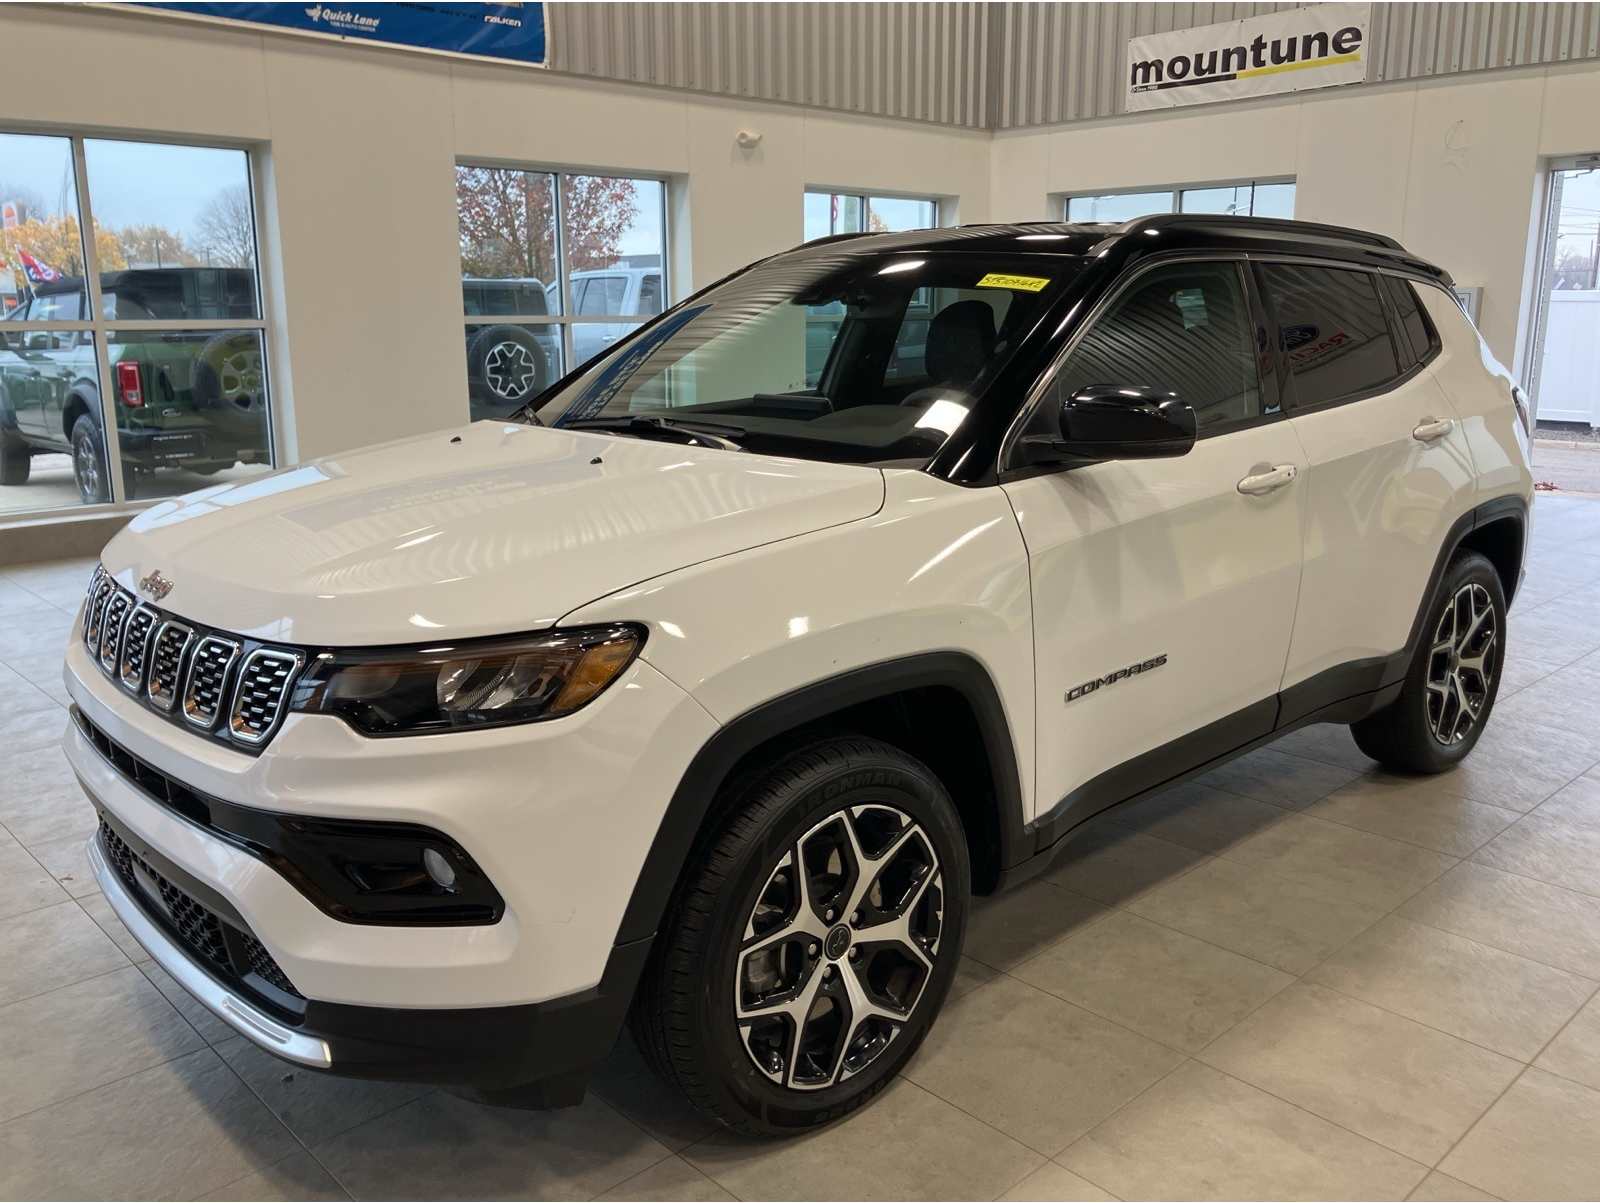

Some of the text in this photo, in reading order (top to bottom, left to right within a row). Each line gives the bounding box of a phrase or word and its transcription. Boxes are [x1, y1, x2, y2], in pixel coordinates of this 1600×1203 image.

[322, 8, 380, 27] Quick Lane
[1131, 26, 1363, 86] mountune
[1064, 653, 1168, 704] COMPASS
